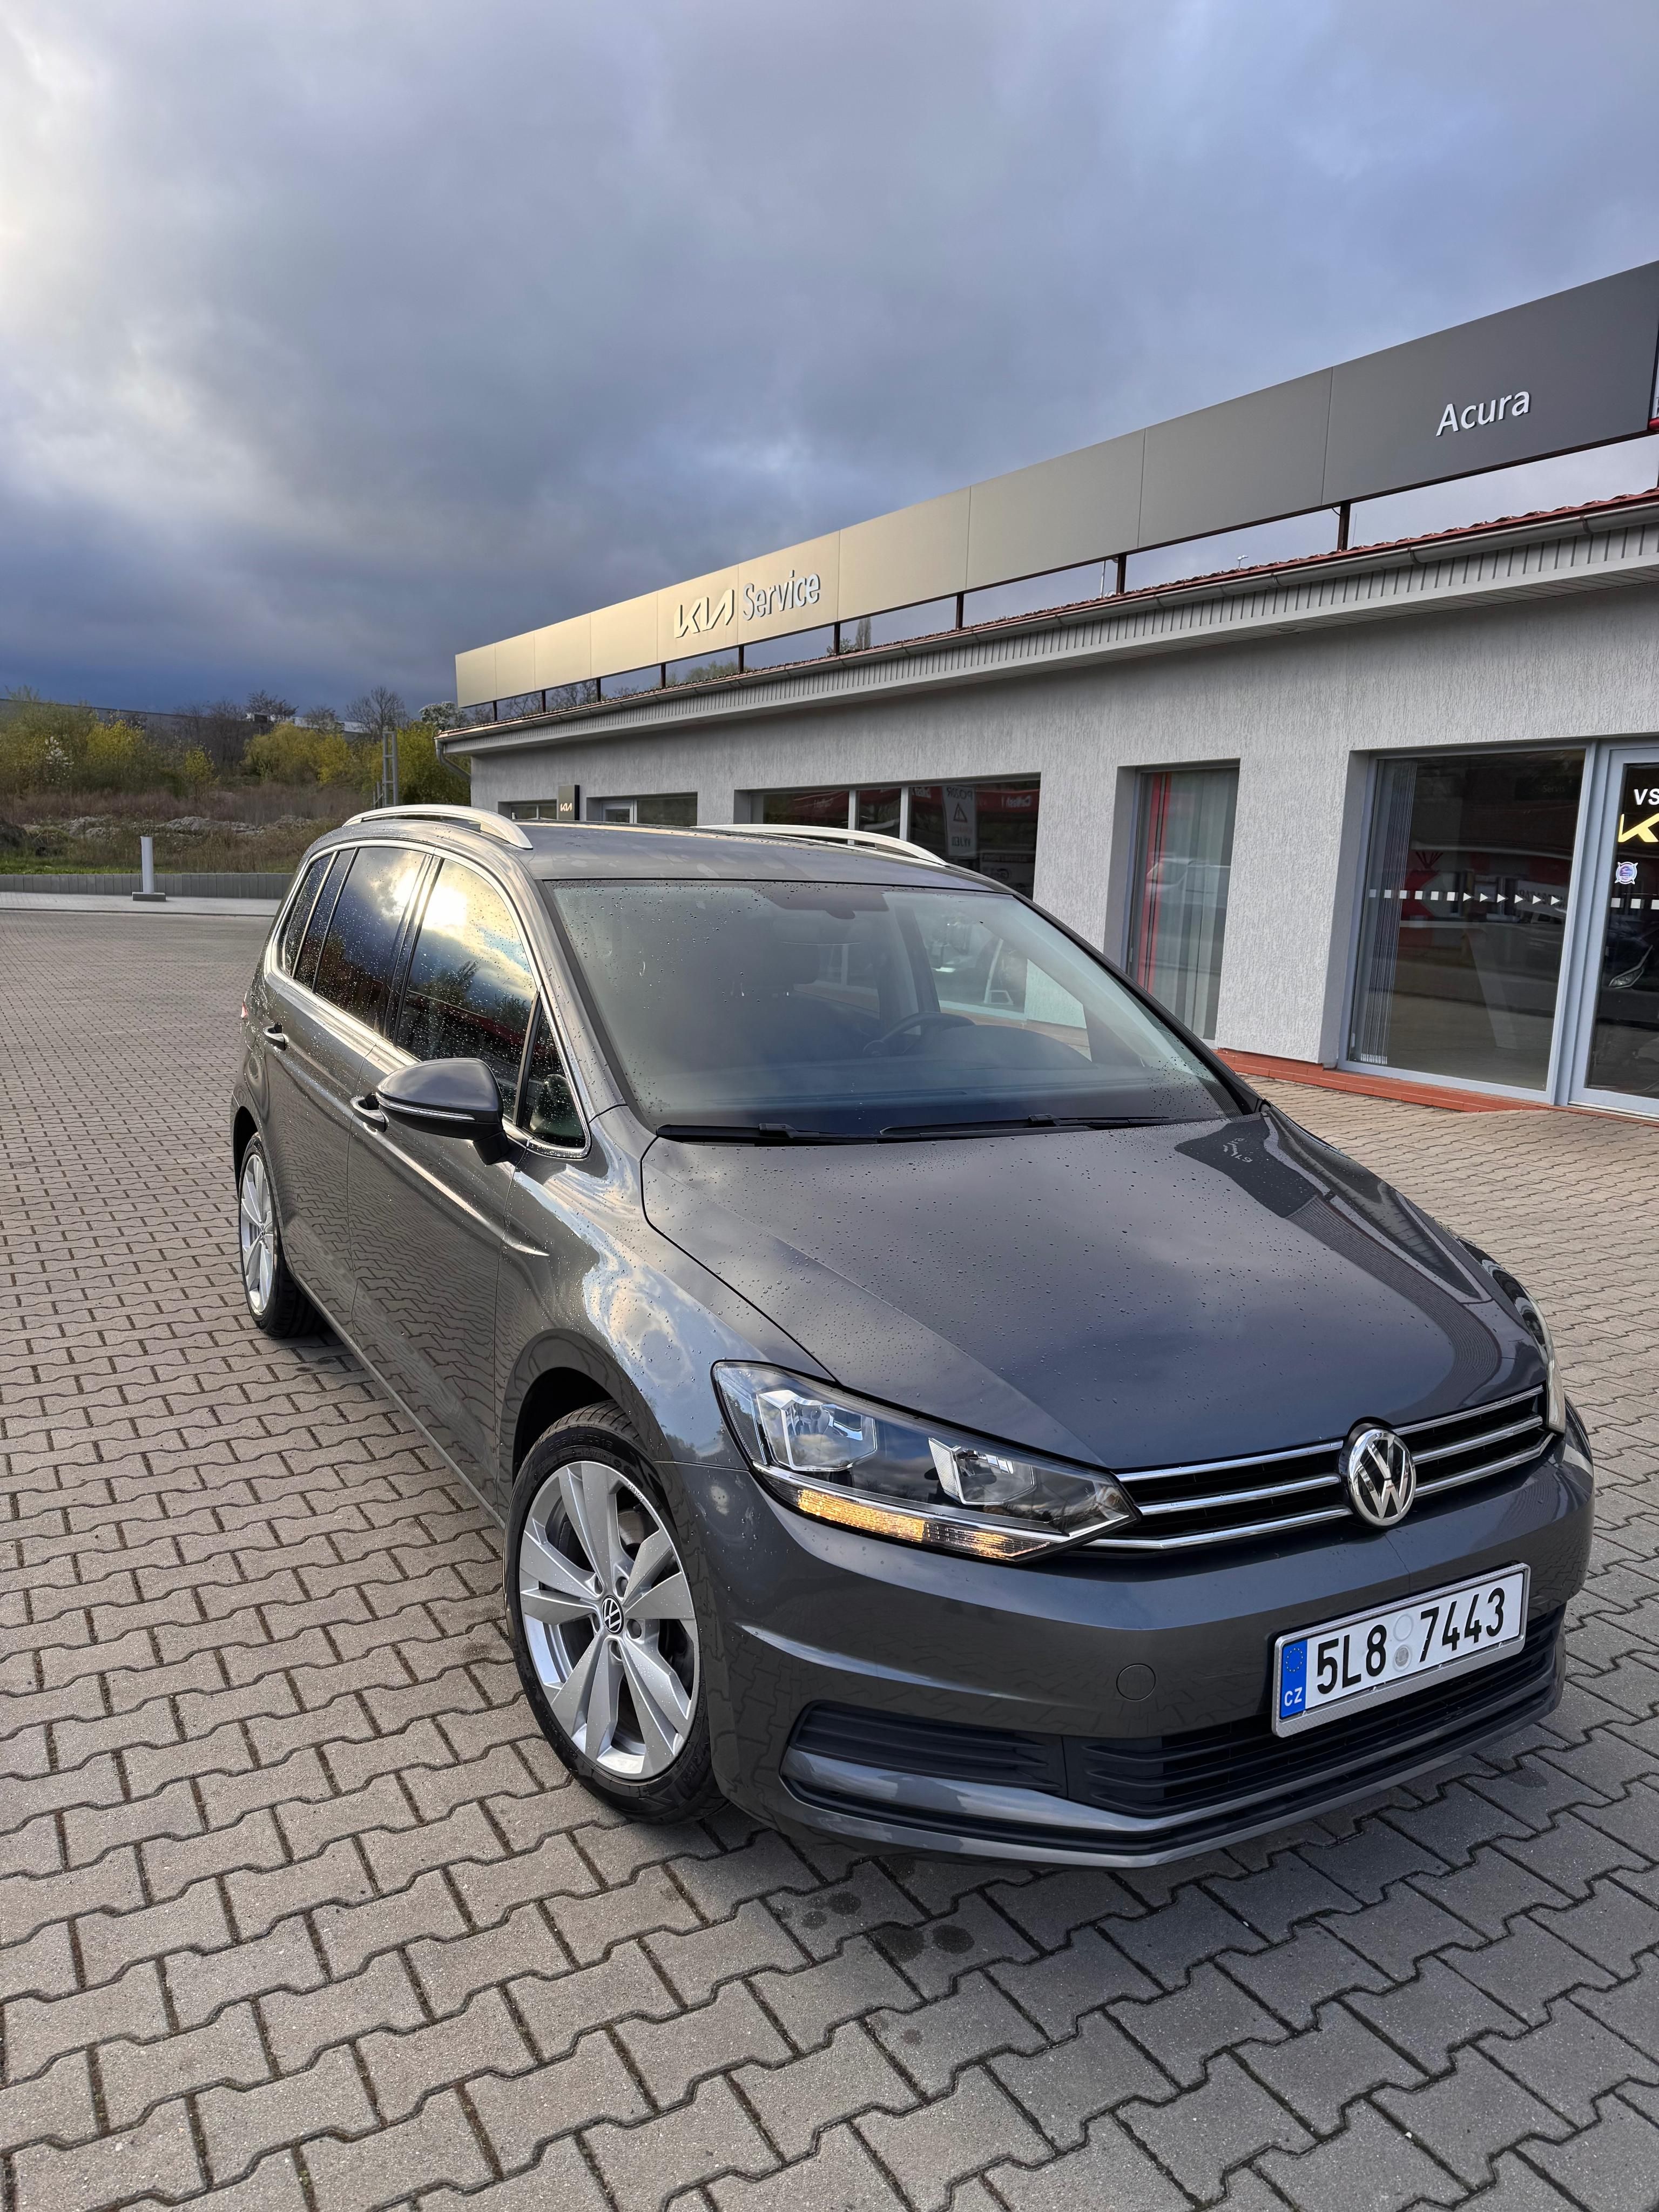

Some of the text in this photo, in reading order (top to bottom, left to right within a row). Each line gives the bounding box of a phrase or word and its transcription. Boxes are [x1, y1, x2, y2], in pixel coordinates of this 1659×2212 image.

[1436, 391, 1532, 437] Acura
[675, 570, 821, 638] KIA Service
[560, 802, 572, 812] KIA
[1634, 788, 1659, 805] VS
[1317, 1587, 1505, 1694] 5L8 7443
[1284, 1687, 1303, 1707] CZ
